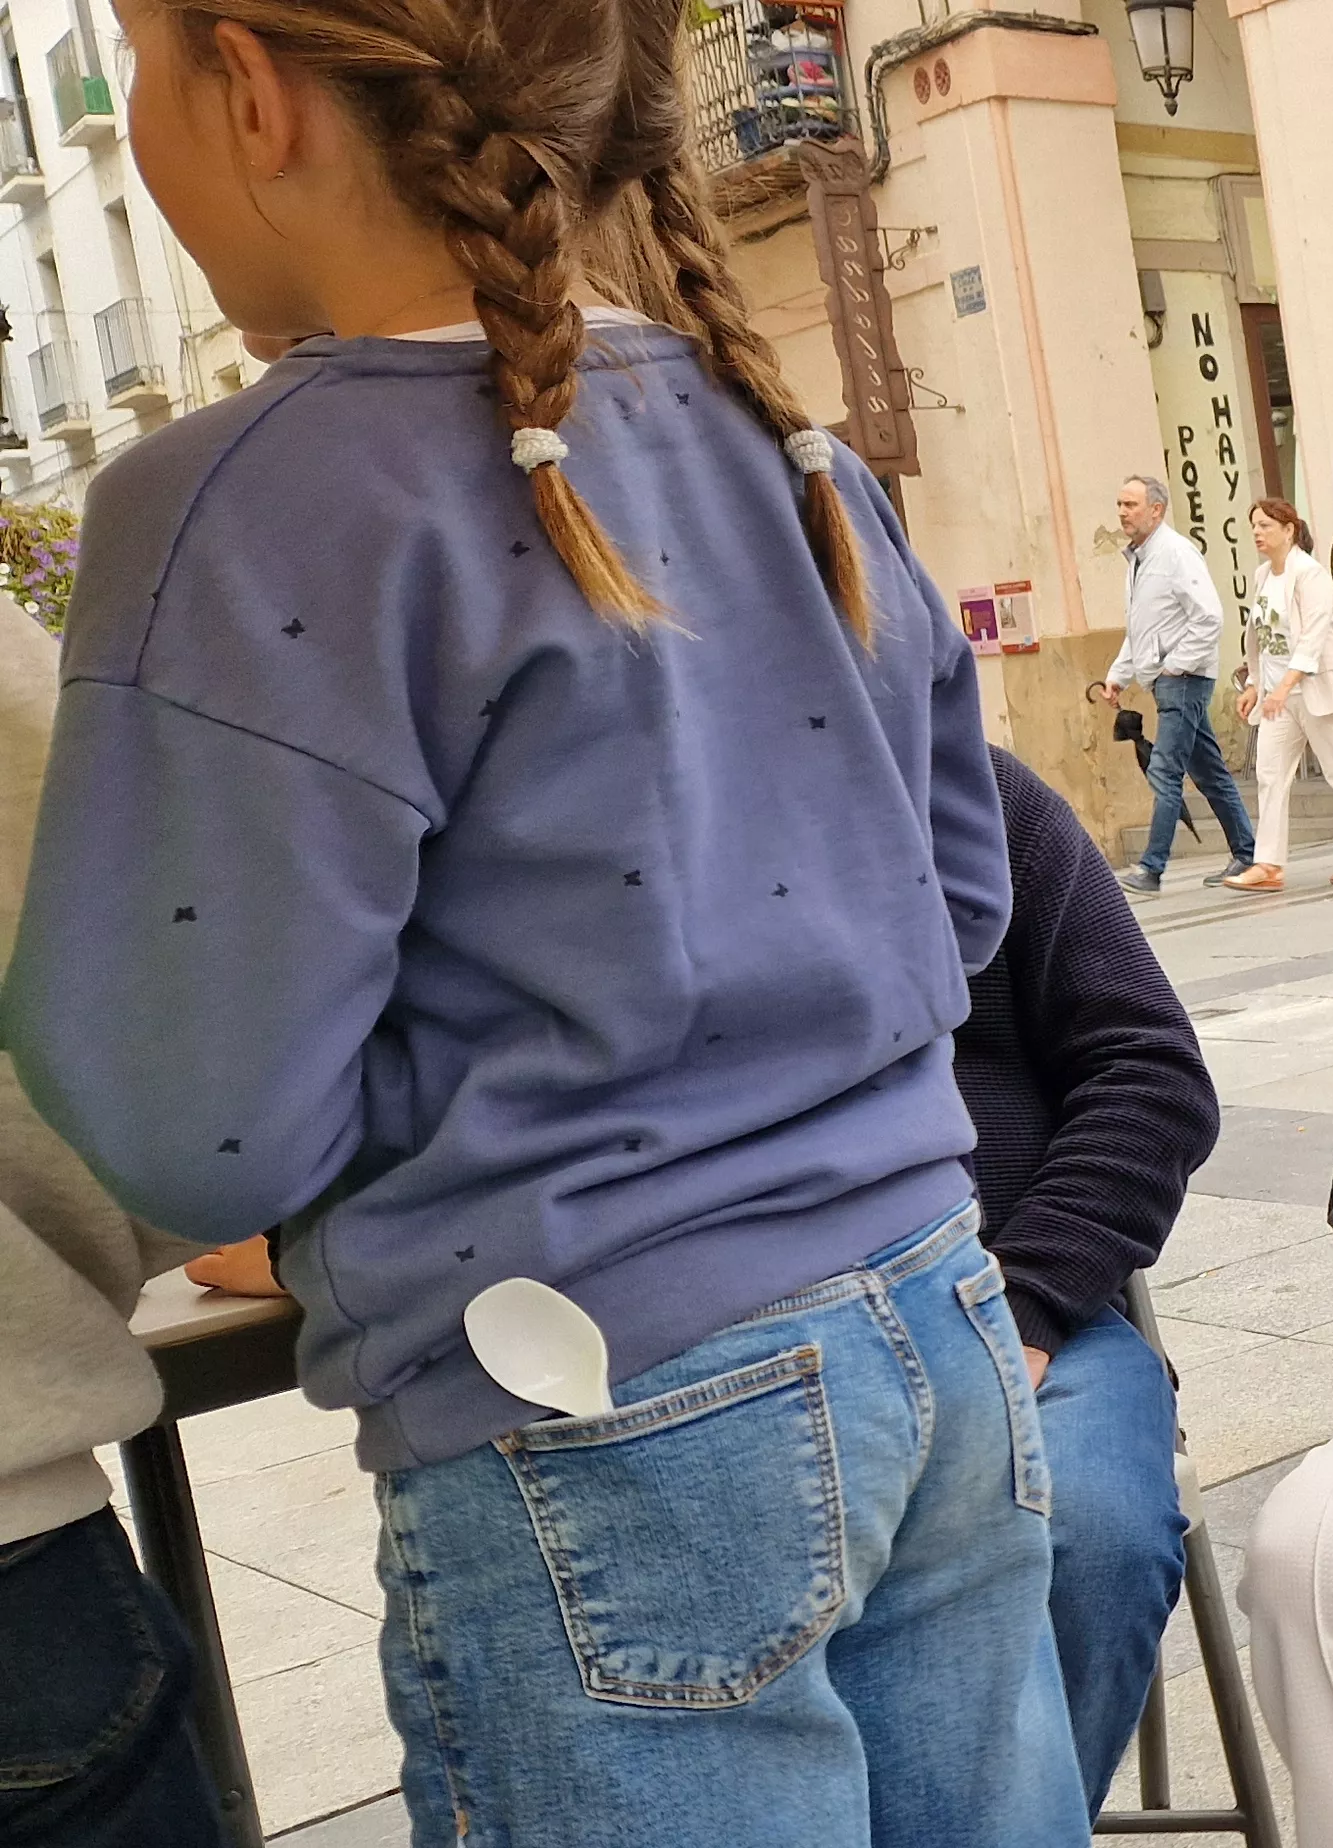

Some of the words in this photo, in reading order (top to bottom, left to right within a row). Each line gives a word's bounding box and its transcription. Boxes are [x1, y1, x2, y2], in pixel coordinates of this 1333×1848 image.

[1191, 312, 1219, 382] NO
[1211, 394, 1240, 501] HAY
[1177, 426, 1208, 556] POES
